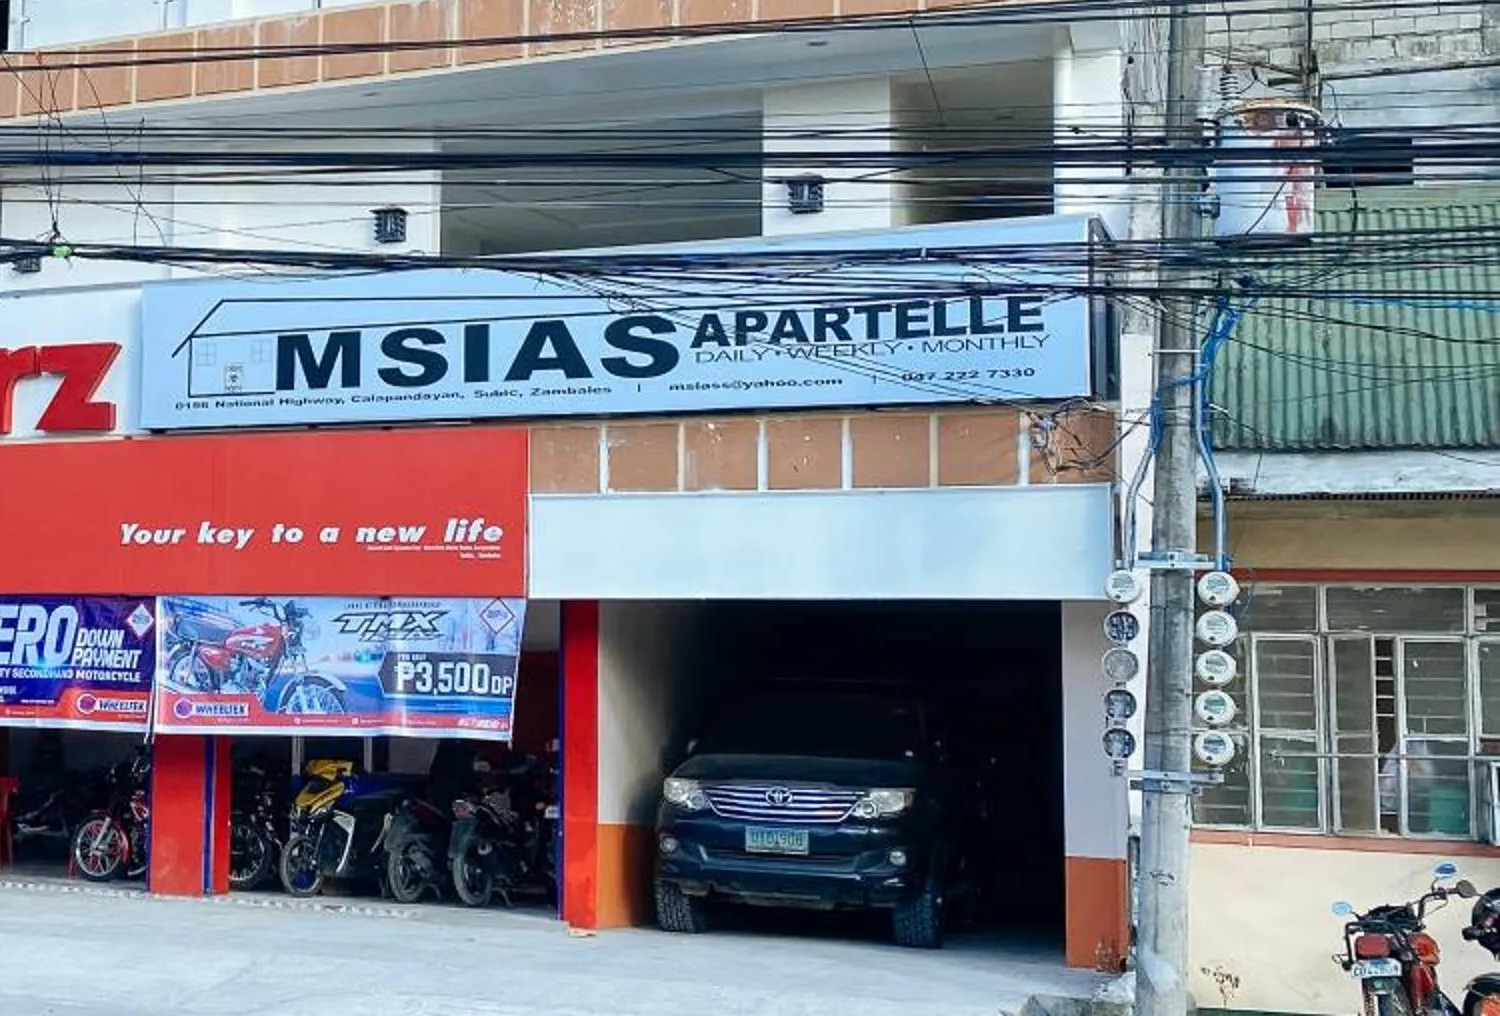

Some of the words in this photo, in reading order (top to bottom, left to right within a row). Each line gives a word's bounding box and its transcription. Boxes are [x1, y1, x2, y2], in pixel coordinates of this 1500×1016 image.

[690, 294, 1045, 349] APARTELLE
[276, 314, 681, 391] MSIAS
[695, 348, 775, 364] DAILY
[786, 342, 902, 360] WEEKLY
[922, 334, 1051, 354] MONTHLY
[215, 397, 275, 409] National
[529, 385, 612, 398] Zambales
[986, 367, 1036, 379] 7330
[120, 522, 187, 546] Your
[197, 521, 255, 550] key
[271, 524, 304, 545] to
[319, 527, 340, 544] a
[355, 525, 427, 544] new
[443, 518, 503, 544] life
[333, 610, 451, 634] TMX
[75, 627, 125, 649] DOWN
[71, 647, 142, 669] PAYMENT
[75, 669, 141, 683] MOTORCYCLE
